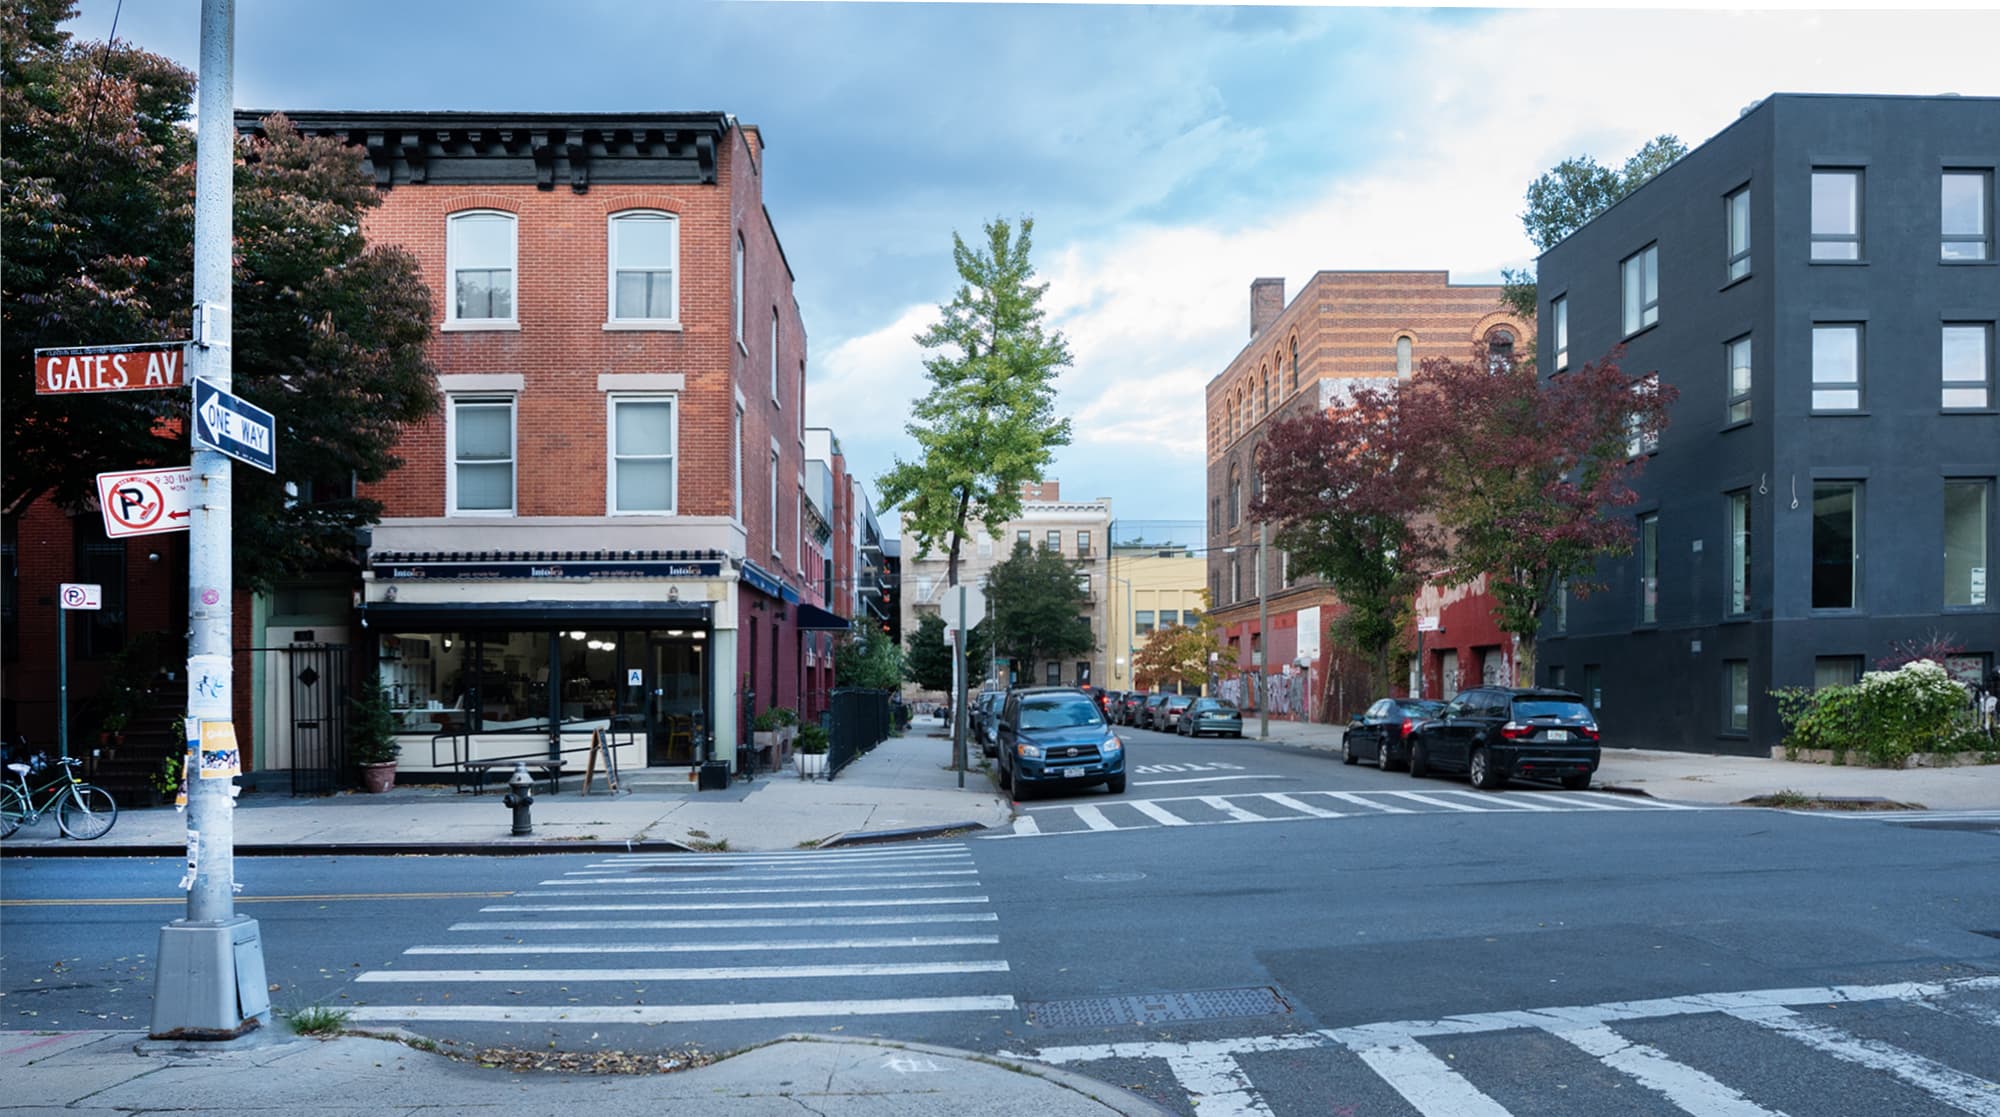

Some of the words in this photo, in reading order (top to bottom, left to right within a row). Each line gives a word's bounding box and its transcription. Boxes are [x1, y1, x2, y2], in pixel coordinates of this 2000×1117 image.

[46, 354, 129, 389] GATES
[145, 351, 178, 385] AV
[208, 403, 231, 435] ONE
[240, 419, 265, 449] WAY
[631, 671, 640, 681] A
[1134, 762, 1244, 773] STOP
